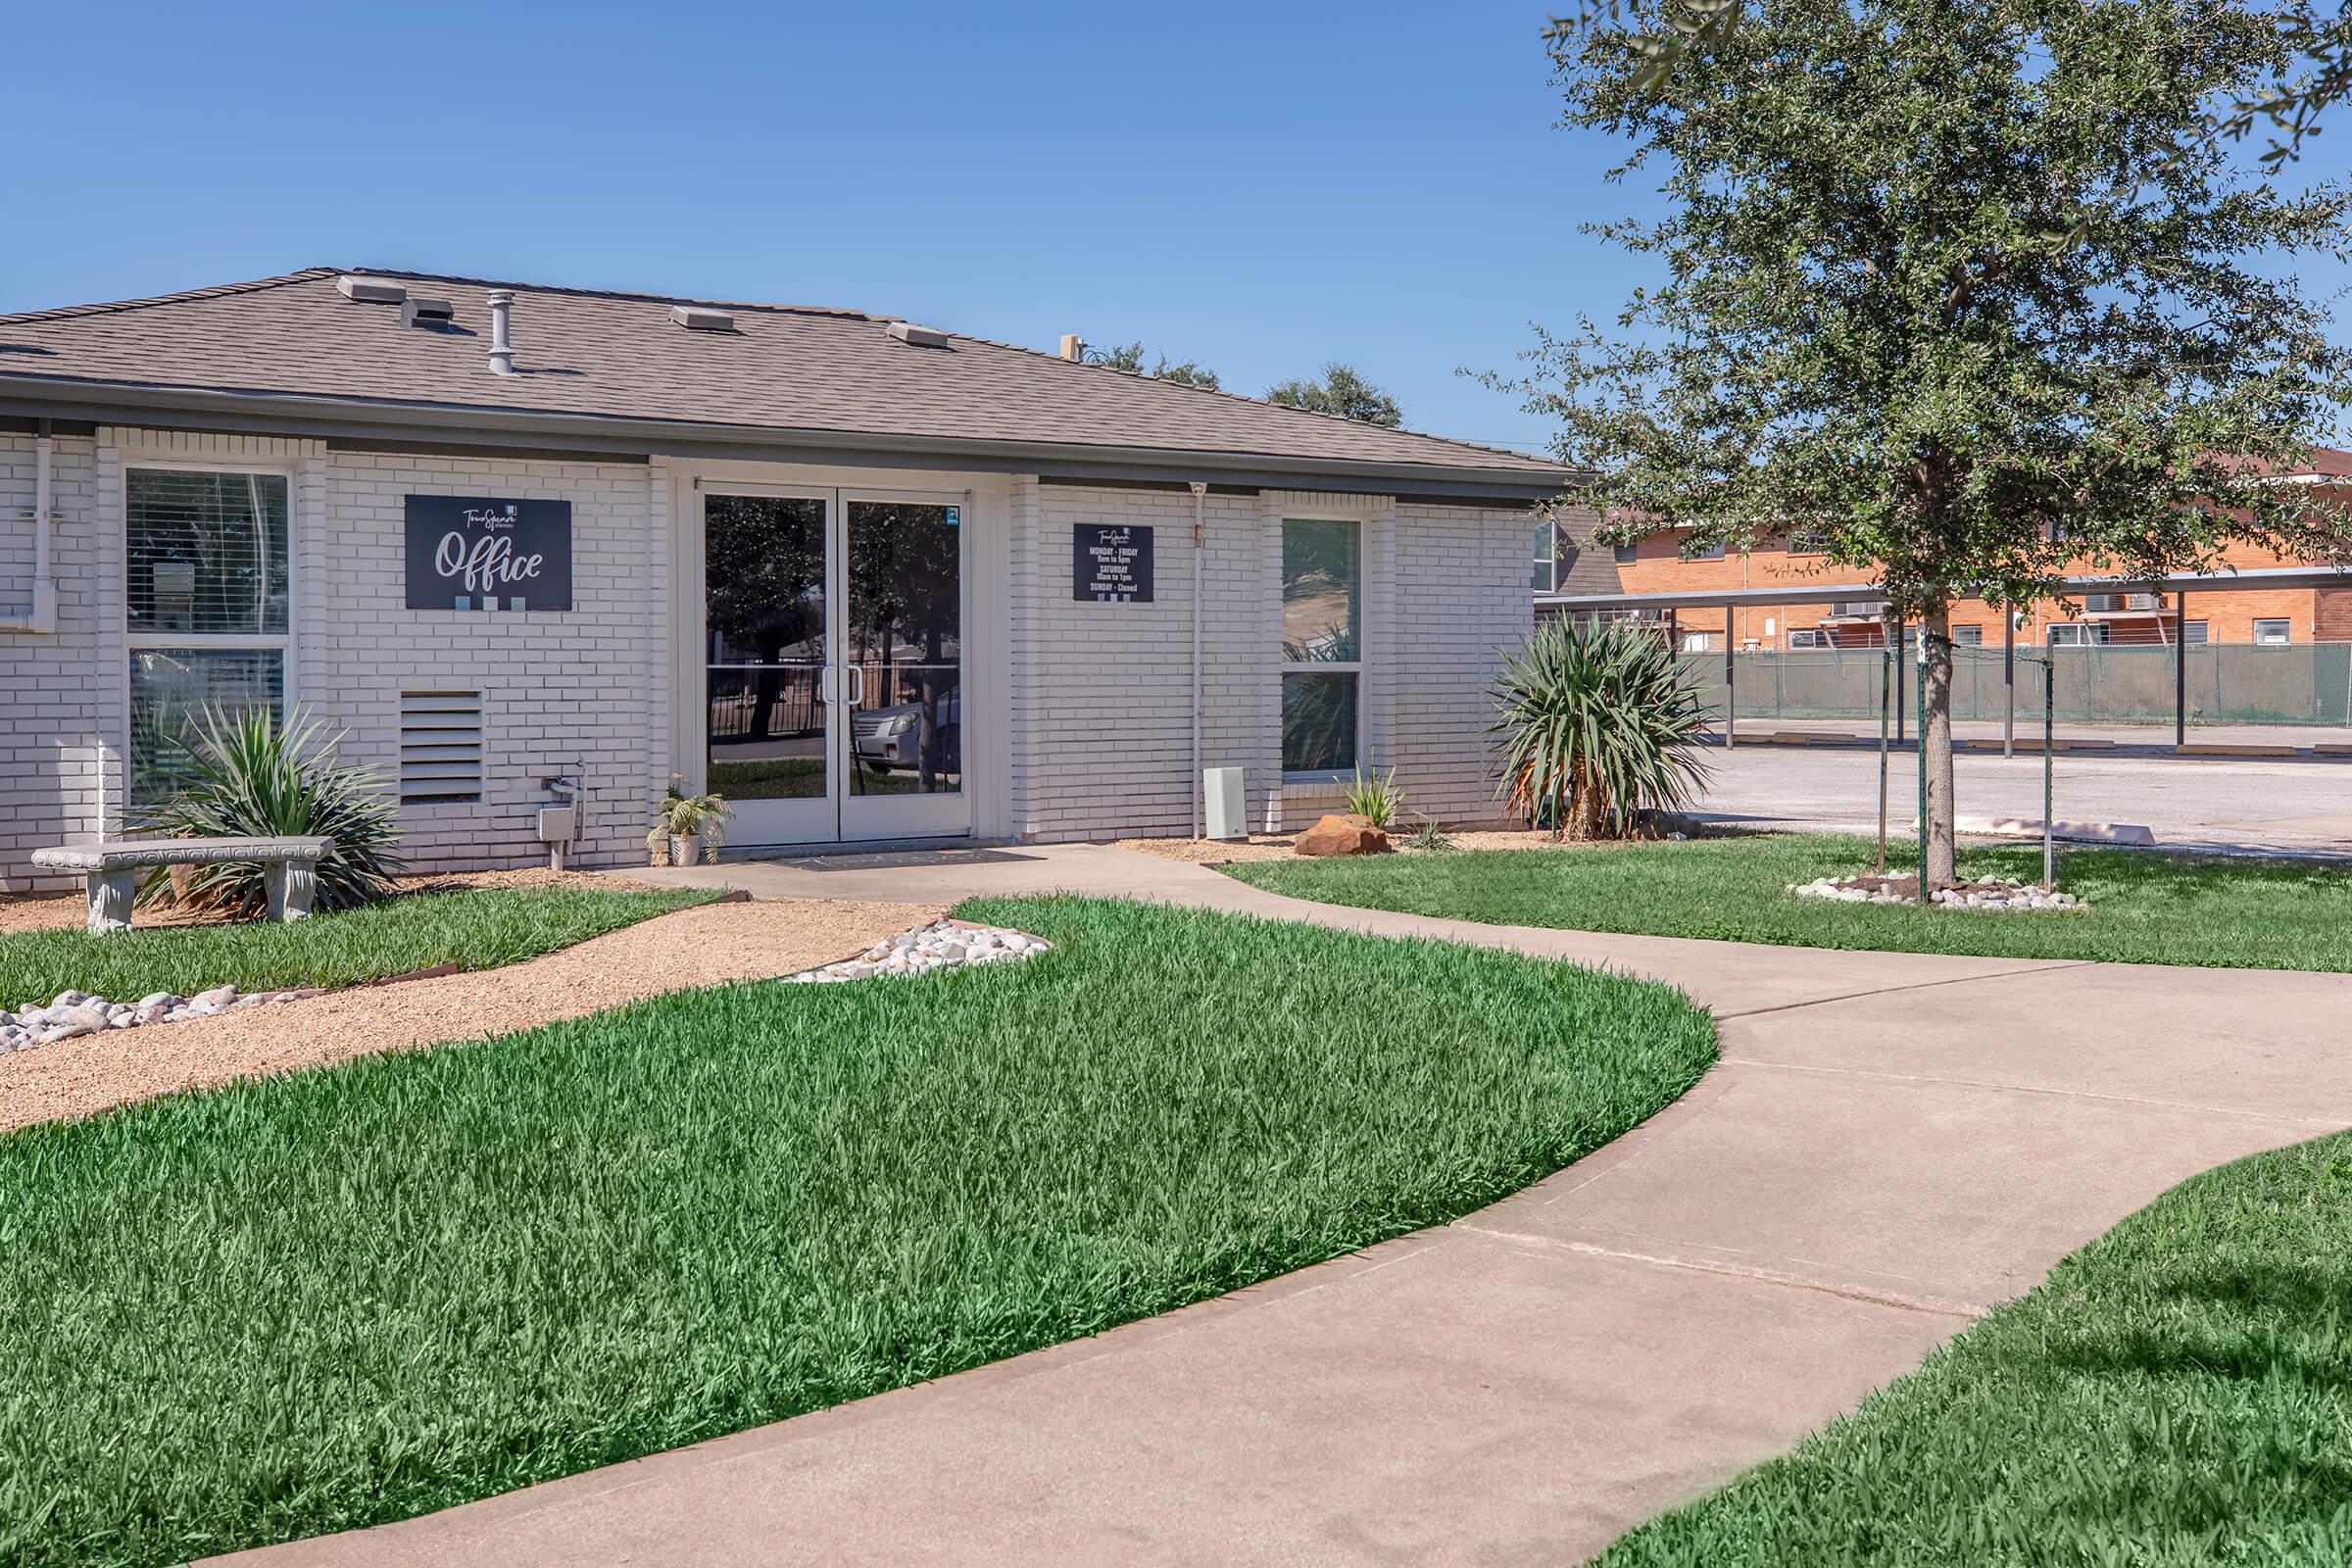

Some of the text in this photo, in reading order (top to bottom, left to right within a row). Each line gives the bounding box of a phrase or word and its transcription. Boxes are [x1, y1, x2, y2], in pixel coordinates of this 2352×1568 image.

[1090, 547, 1113, 556] MONDAY
[1118, 548, 1138, 556] FRIDAY
[435, 530, 543, 592] Office
[1090, 583, 1112, 591] SUNDAY
